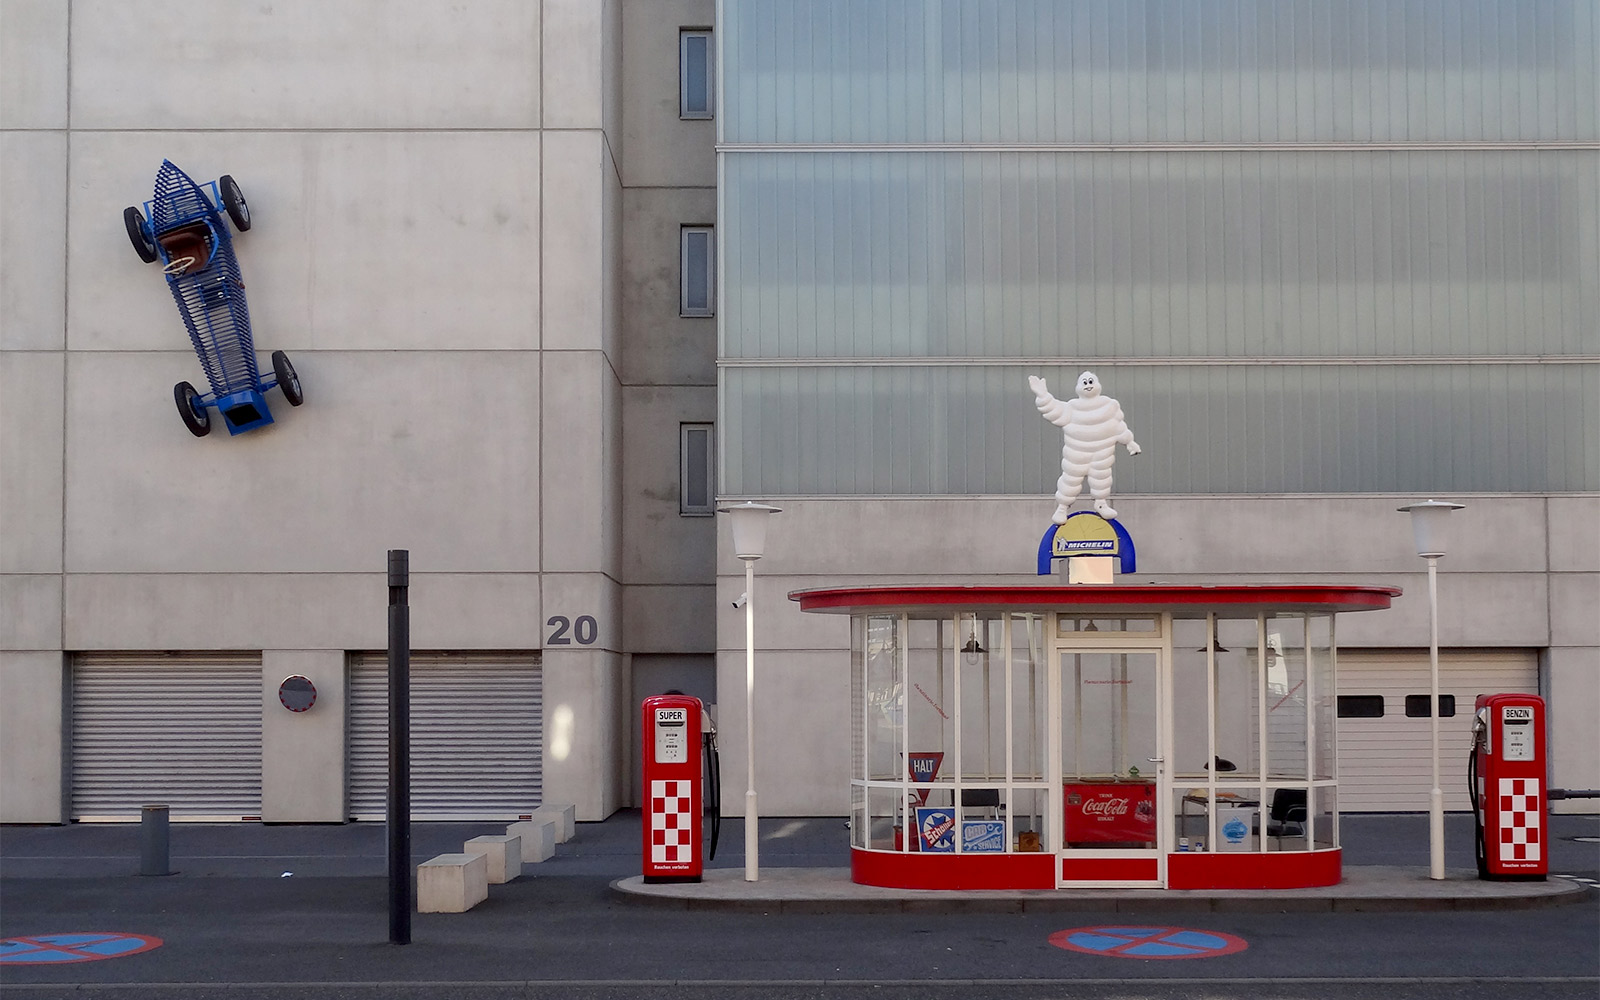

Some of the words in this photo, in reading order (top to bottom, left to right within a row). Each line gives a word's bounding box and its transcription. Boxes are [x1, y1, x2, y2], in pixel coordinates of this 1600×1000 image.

[1067, 541, 1113, 549] MICHELIN
[546, 615, 599, 645] 20
[659, 711, 683, 720] SUPER
[1505, 709, 1531, 718] BENZIN
[913, 759, 934, 773] HALT
